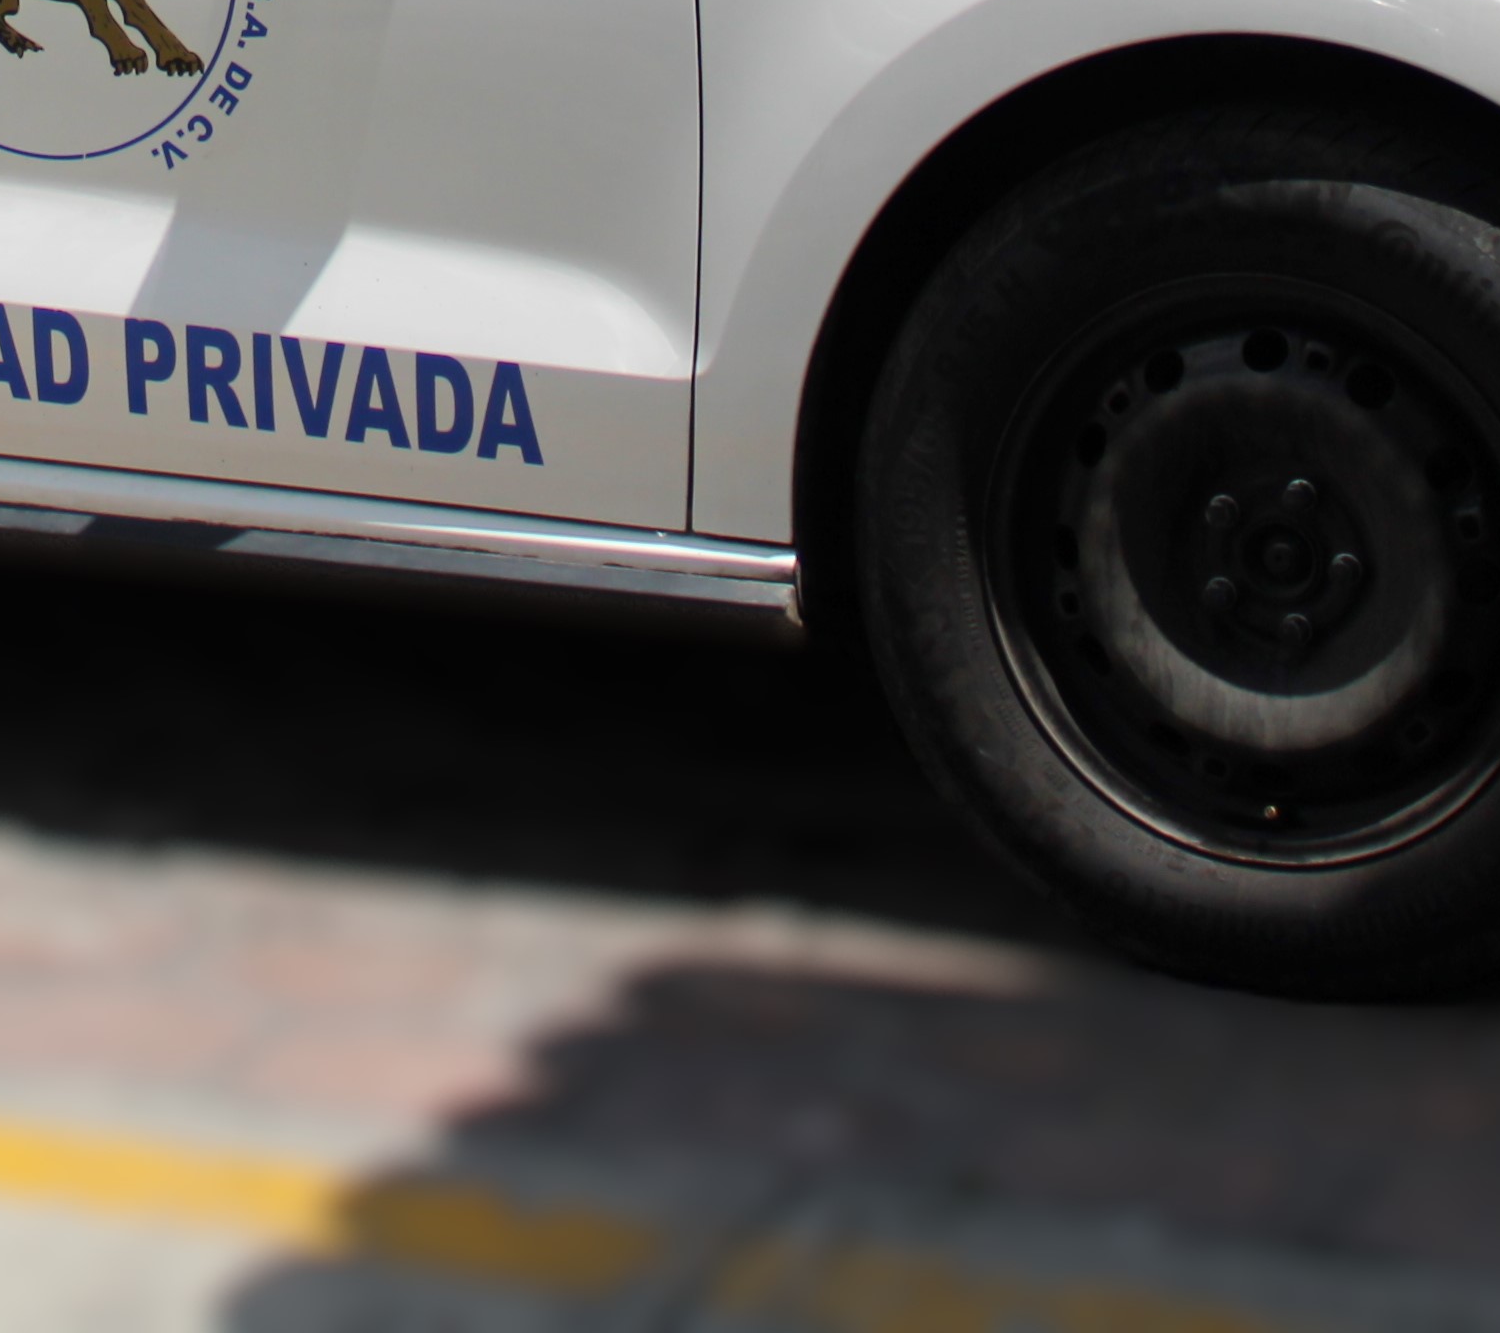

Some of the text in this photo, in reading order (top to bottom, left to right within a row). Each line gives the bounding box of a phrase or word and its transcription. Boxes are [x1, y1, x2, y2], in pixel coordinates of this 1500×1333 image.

[208, 61, 253, 116] DE
[150, 114, 214, 170] C.V.
[126, 320, 542, 466] PRIVADA
